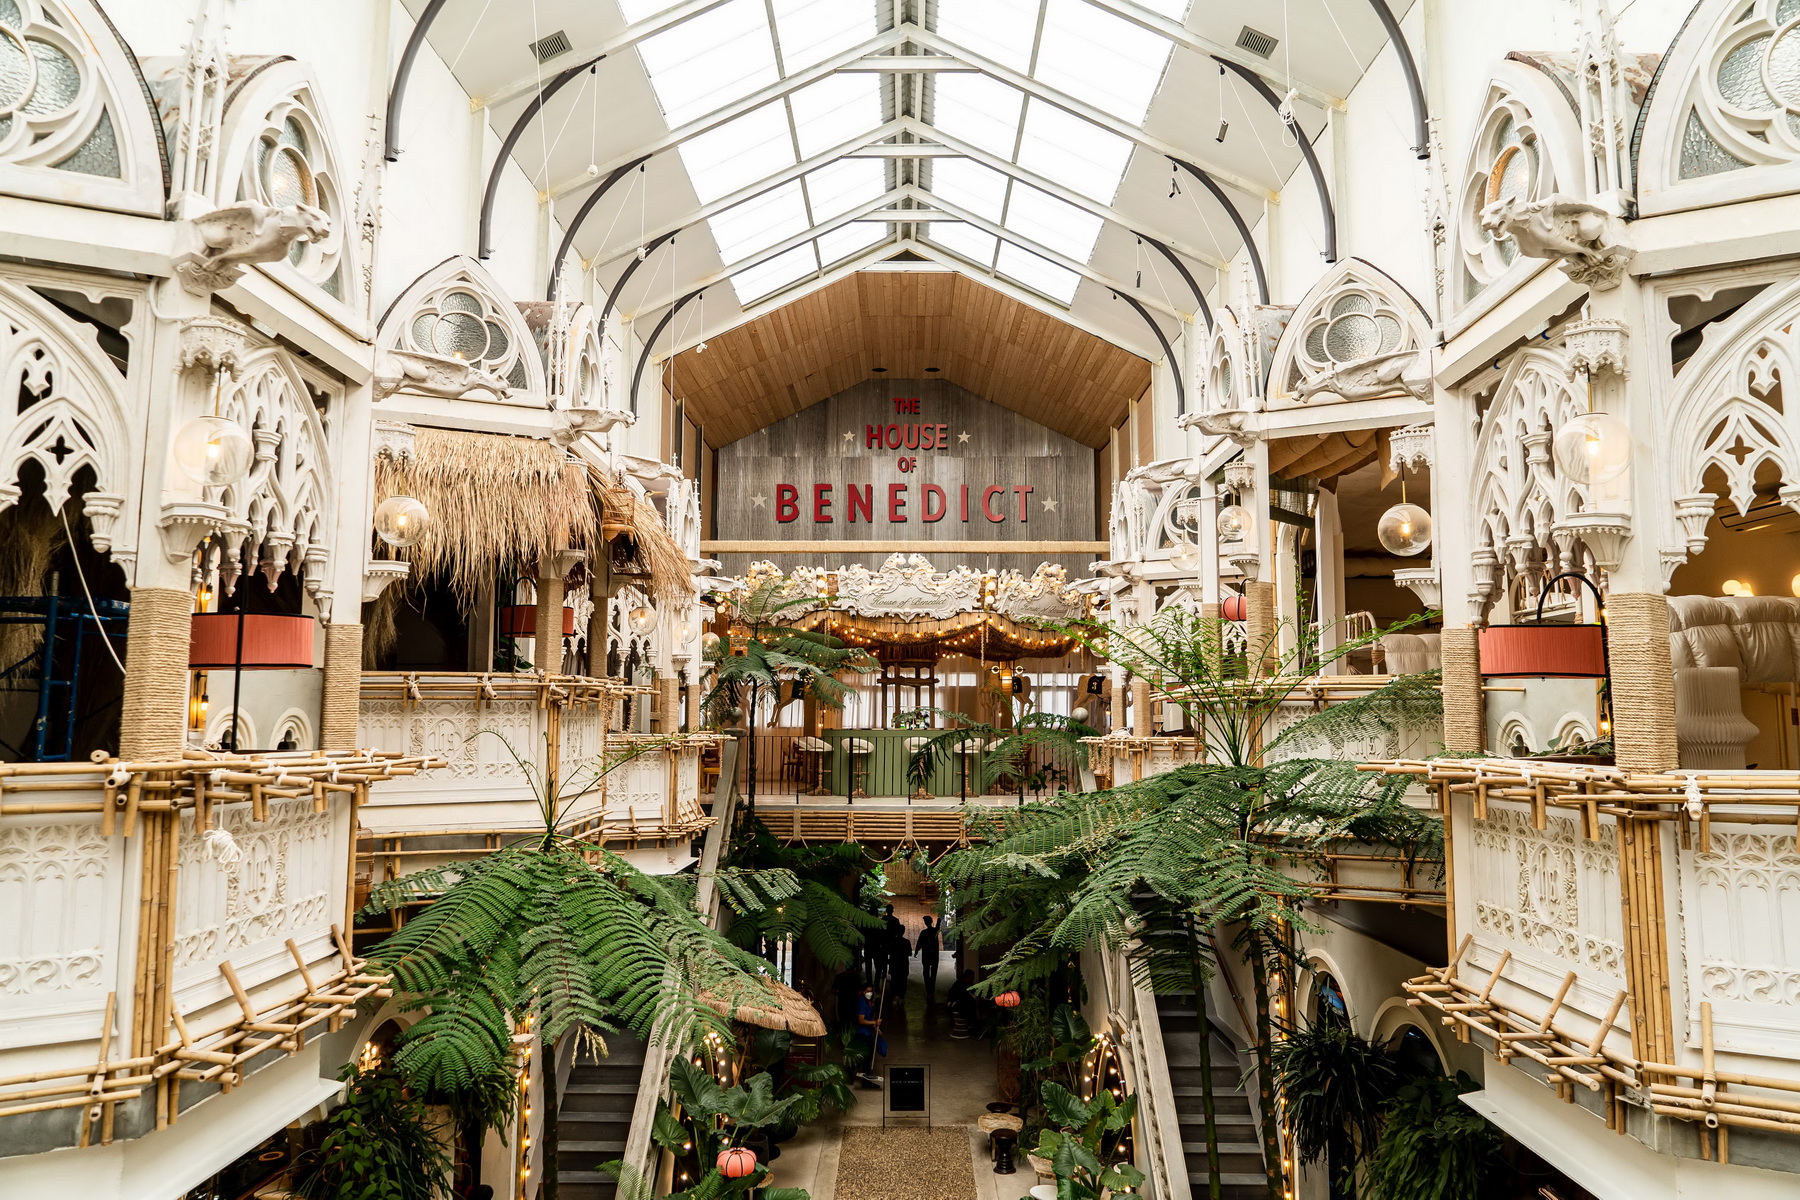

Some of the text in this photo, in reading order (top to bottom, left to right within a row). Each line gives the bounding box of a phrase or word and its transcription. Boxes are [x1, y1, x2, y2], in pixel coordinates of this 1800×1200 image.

[892, 398, 921, 414] THE
[866, 424, 948, 450] HOUSE
[897, 456, 917, 473] OF
[775, 483, 1034, 523] BENEDICT
[871, 595, 947, 607] House of Benedict
[1092, 681, 1097, 690] 3
